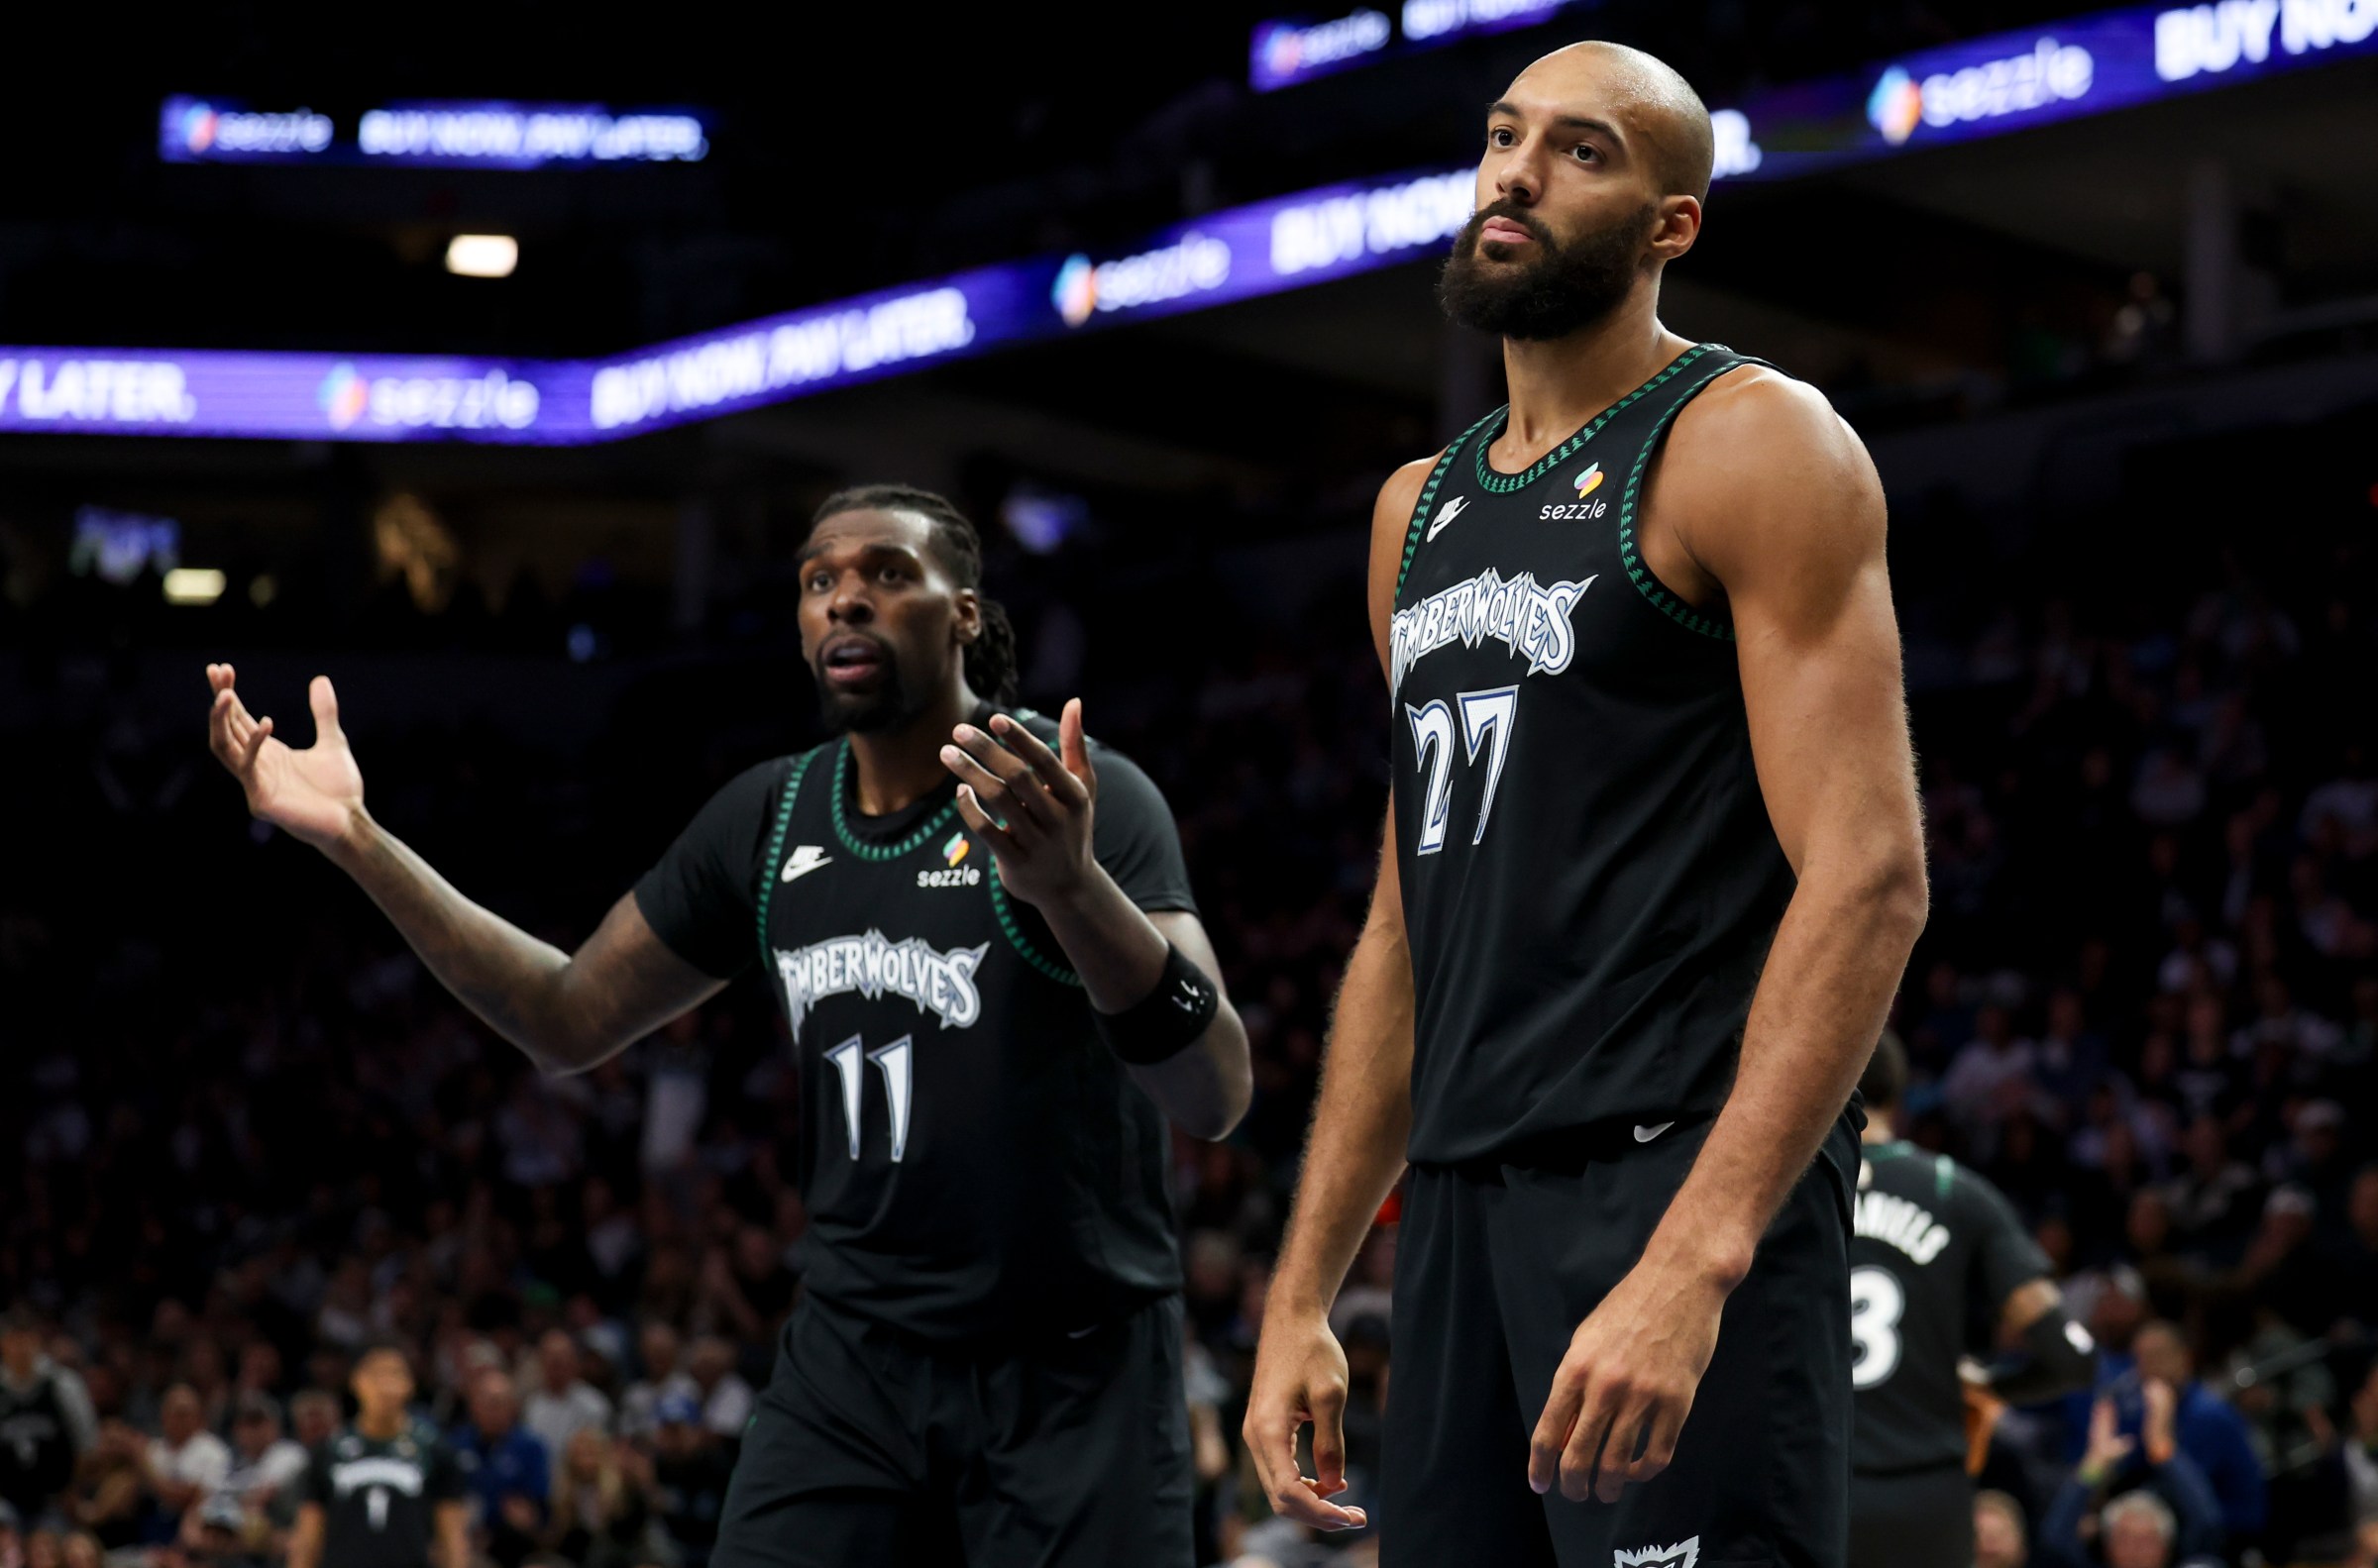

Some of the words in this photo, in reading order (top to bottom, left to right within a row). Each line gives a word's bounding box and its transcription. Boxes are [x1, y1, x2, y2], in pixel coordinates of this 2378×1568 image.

[1920, 38, 2093, 128] sezzle
[2154, 0, 2278, 82] BUY
[1539, 498, 1607, 521] sezzle
[1404, 684, 1520, 857] 27
[917, 864, 981, 888] sezzle
[823, 1033, 913, 1163] 11
